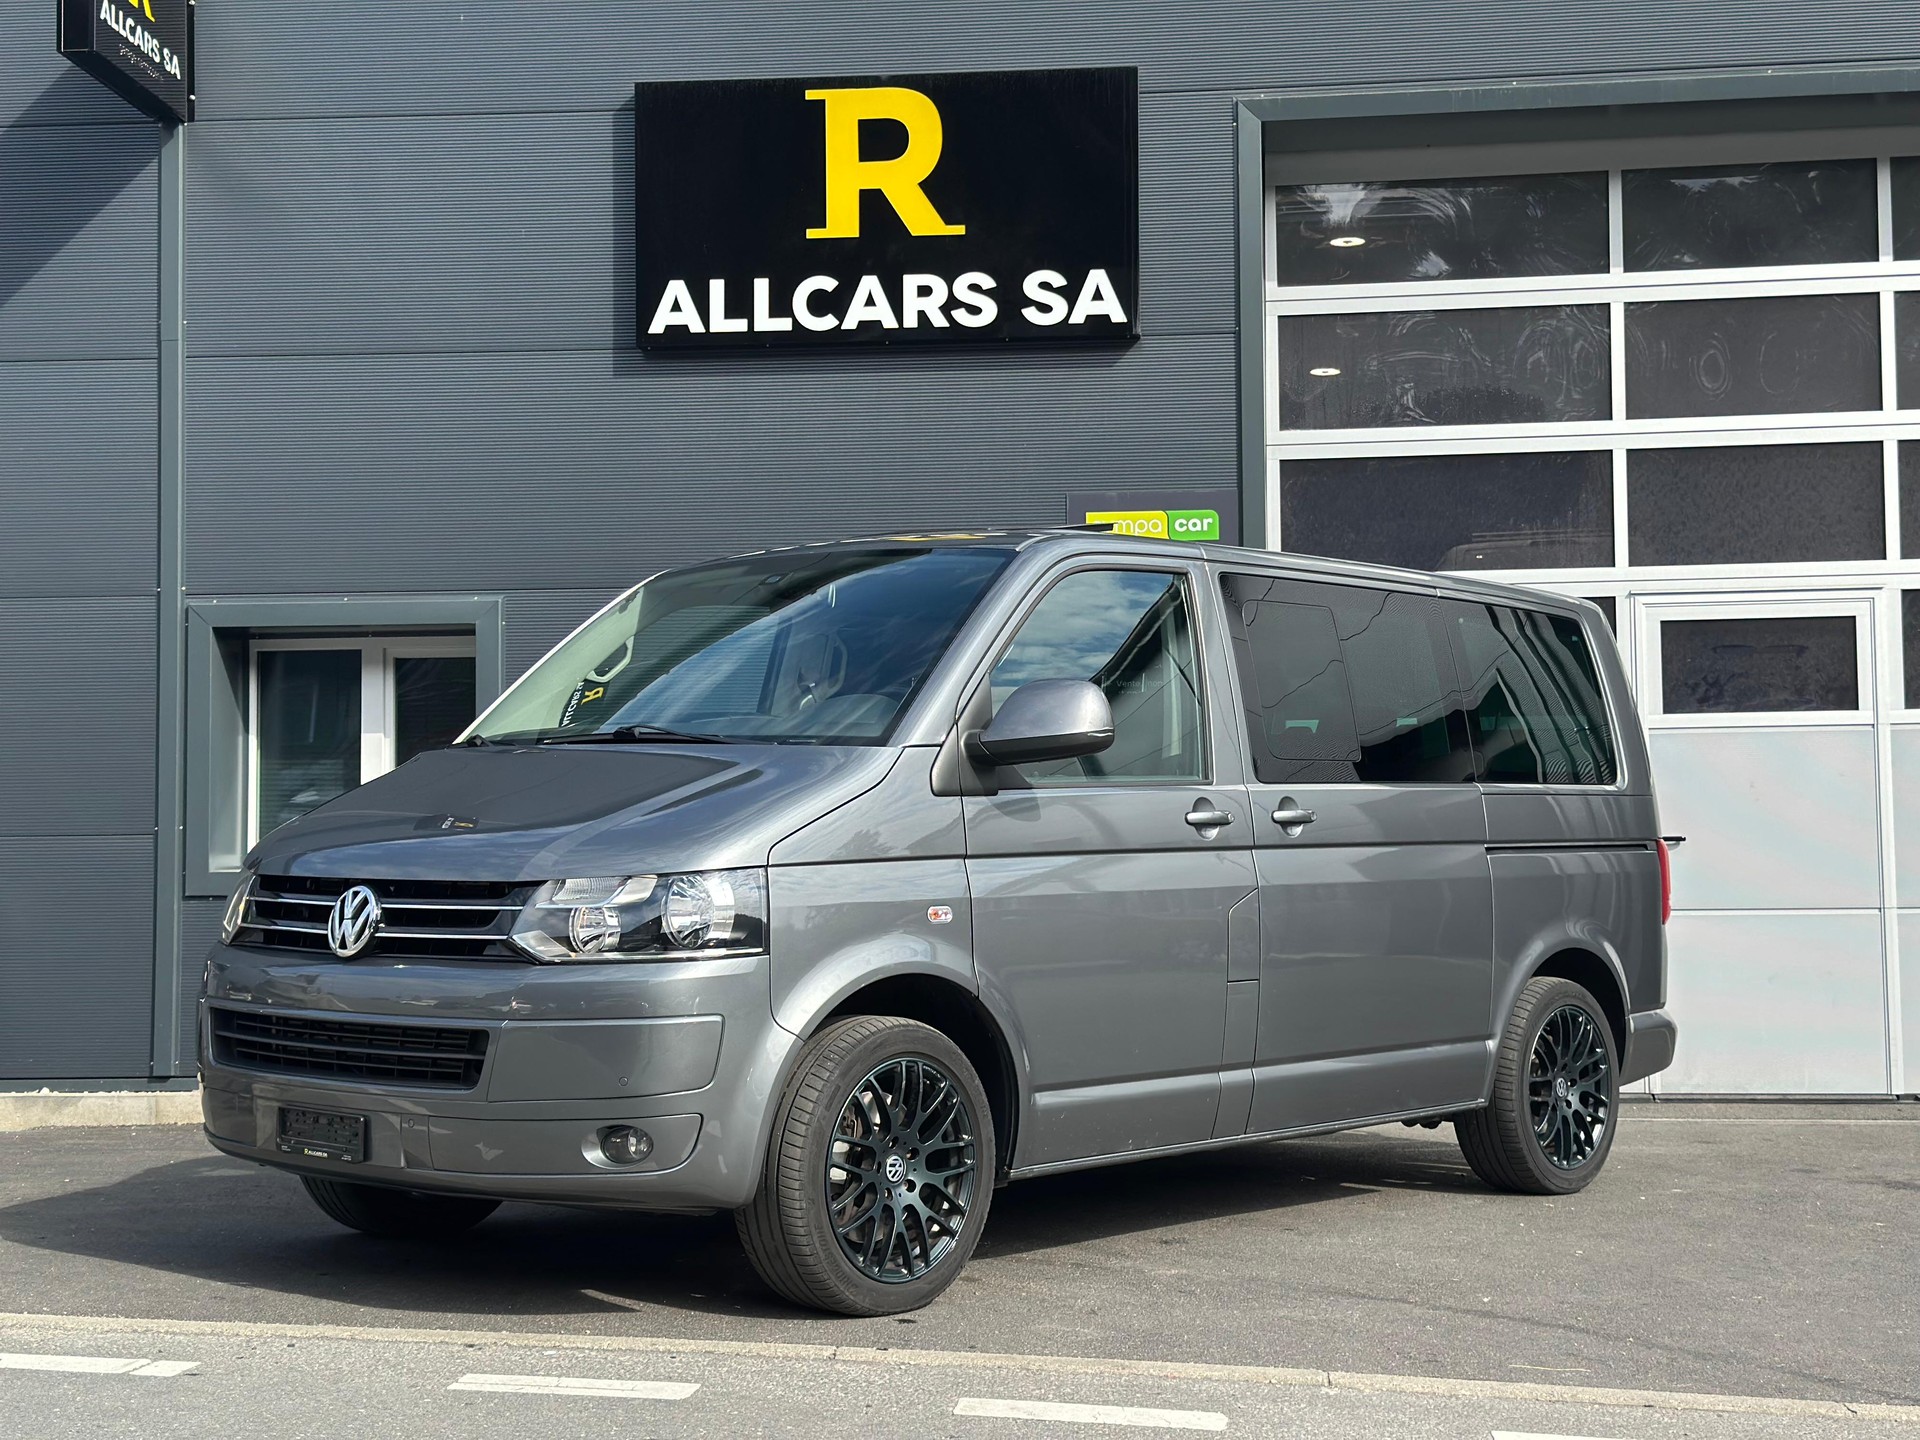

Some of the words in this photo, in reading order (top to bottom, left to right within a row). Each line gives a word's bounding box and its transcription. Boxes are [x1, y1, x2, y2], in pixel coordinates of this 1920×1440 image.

[100, 0, 161, 63] ALLCARS
[163, 48, 181, 80] SA
[805, 86, 966, 240] R
[647, 271, 999, 334] ALLCARS
[1020, 269, 1129, 326] SA
[1174, 517, 1213, 532] car
